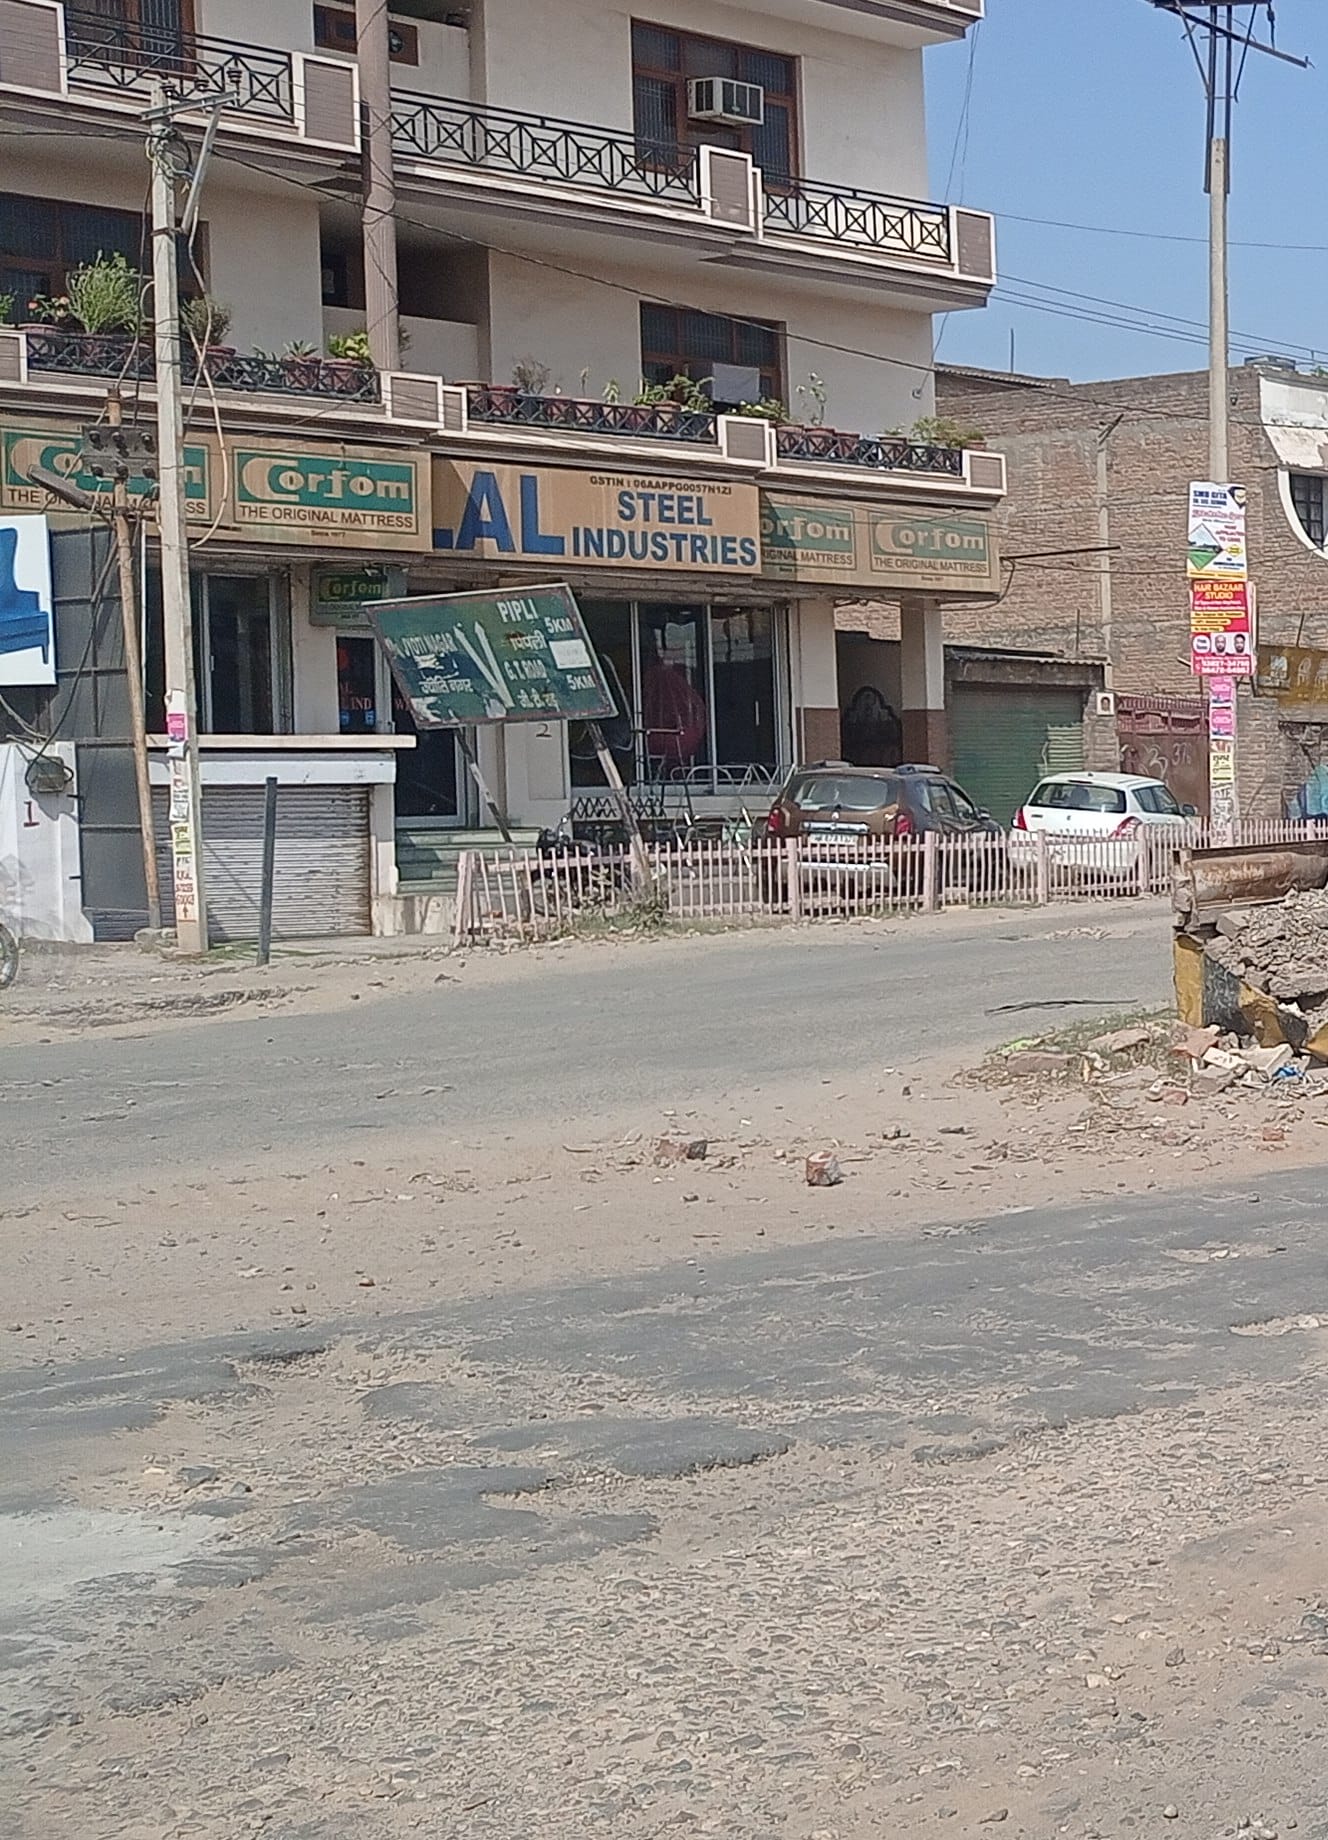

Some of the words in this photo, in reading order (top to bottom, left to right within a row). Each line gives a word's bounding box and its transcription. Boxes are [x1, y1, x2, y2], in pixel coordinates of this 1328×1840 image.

[590, 476, 624, 487] GSTIN
[8, 489, 41, 503] THE
[432, 471, 565, 555] AL
[617, 491, 713, 526] STEEL
[239, 505, 267, 518] THE
[271, 507, 339, 524] ORIGINAL
[340, 512, 413, 529] MATTRESS
[572, 526, 757, 566] INDUSTRIES
[801, 552, 853, 565] MATTRESS
[874, 557, 893, 567] THE
[894, 558, 938, 570] ORIGINAL
[939, 561, 987, 572] MATTRESS
[497, 599, 537, 622] PIPLI
[545, 618, 574, 634] 5KM
[566, 675, 597, 690] 5KM
